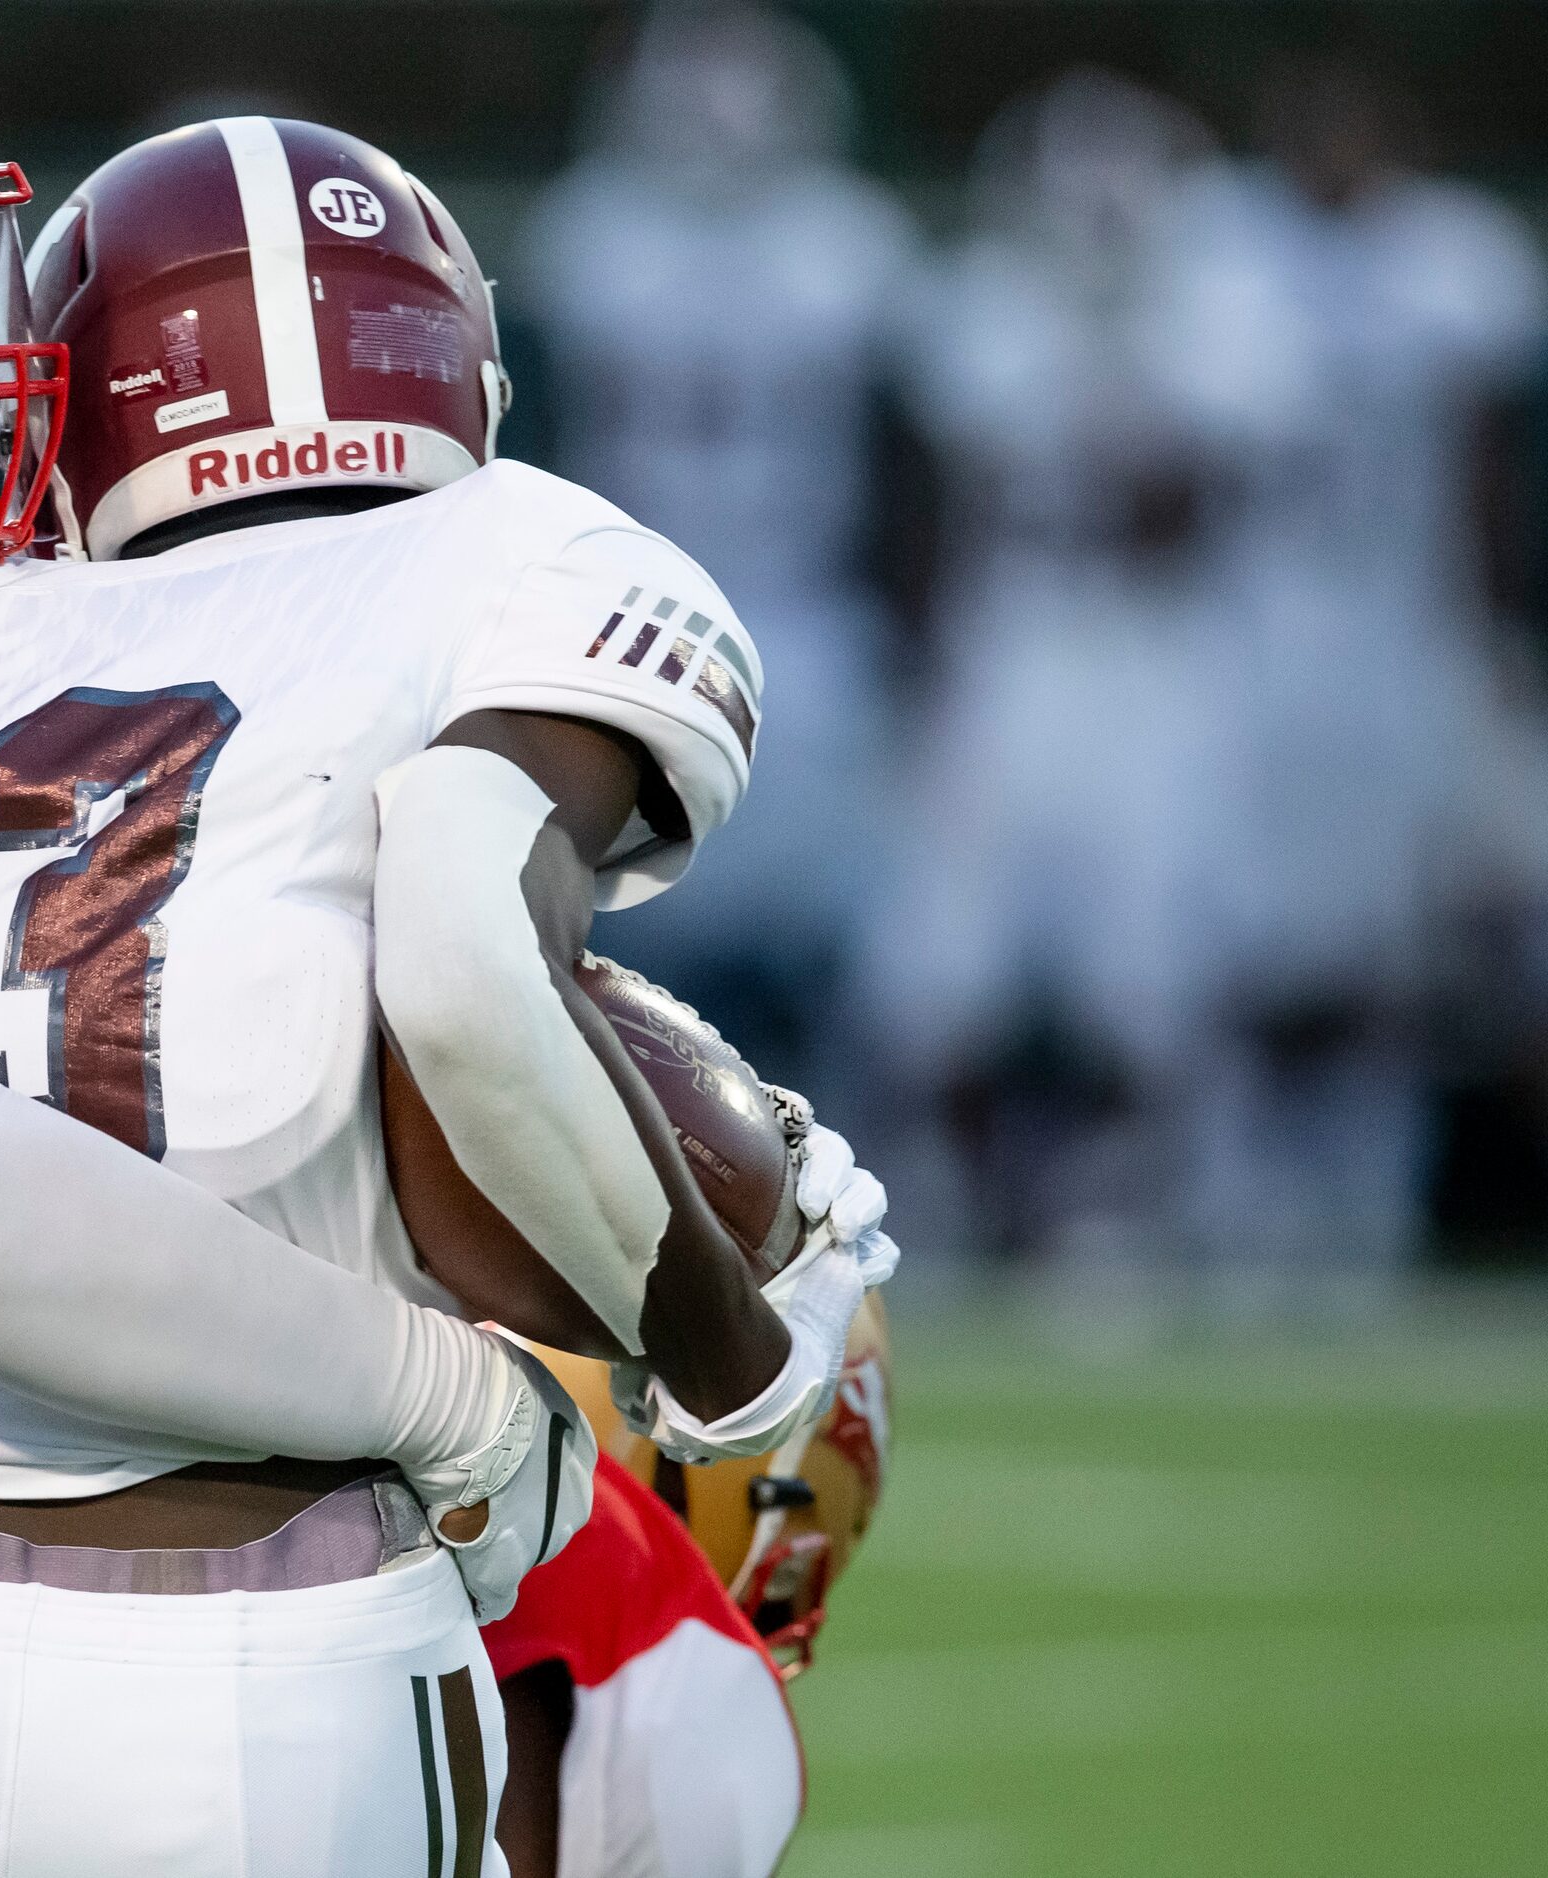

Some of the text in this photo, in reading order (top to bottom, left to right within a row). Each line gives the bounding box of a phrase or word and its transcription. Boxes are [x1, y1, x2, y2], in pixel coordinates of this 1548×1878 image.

[319, 188, 378, 227] JE
[189, 431, 405, 497] Riddell
[682, 1135, 738, 1185] ISSUE
